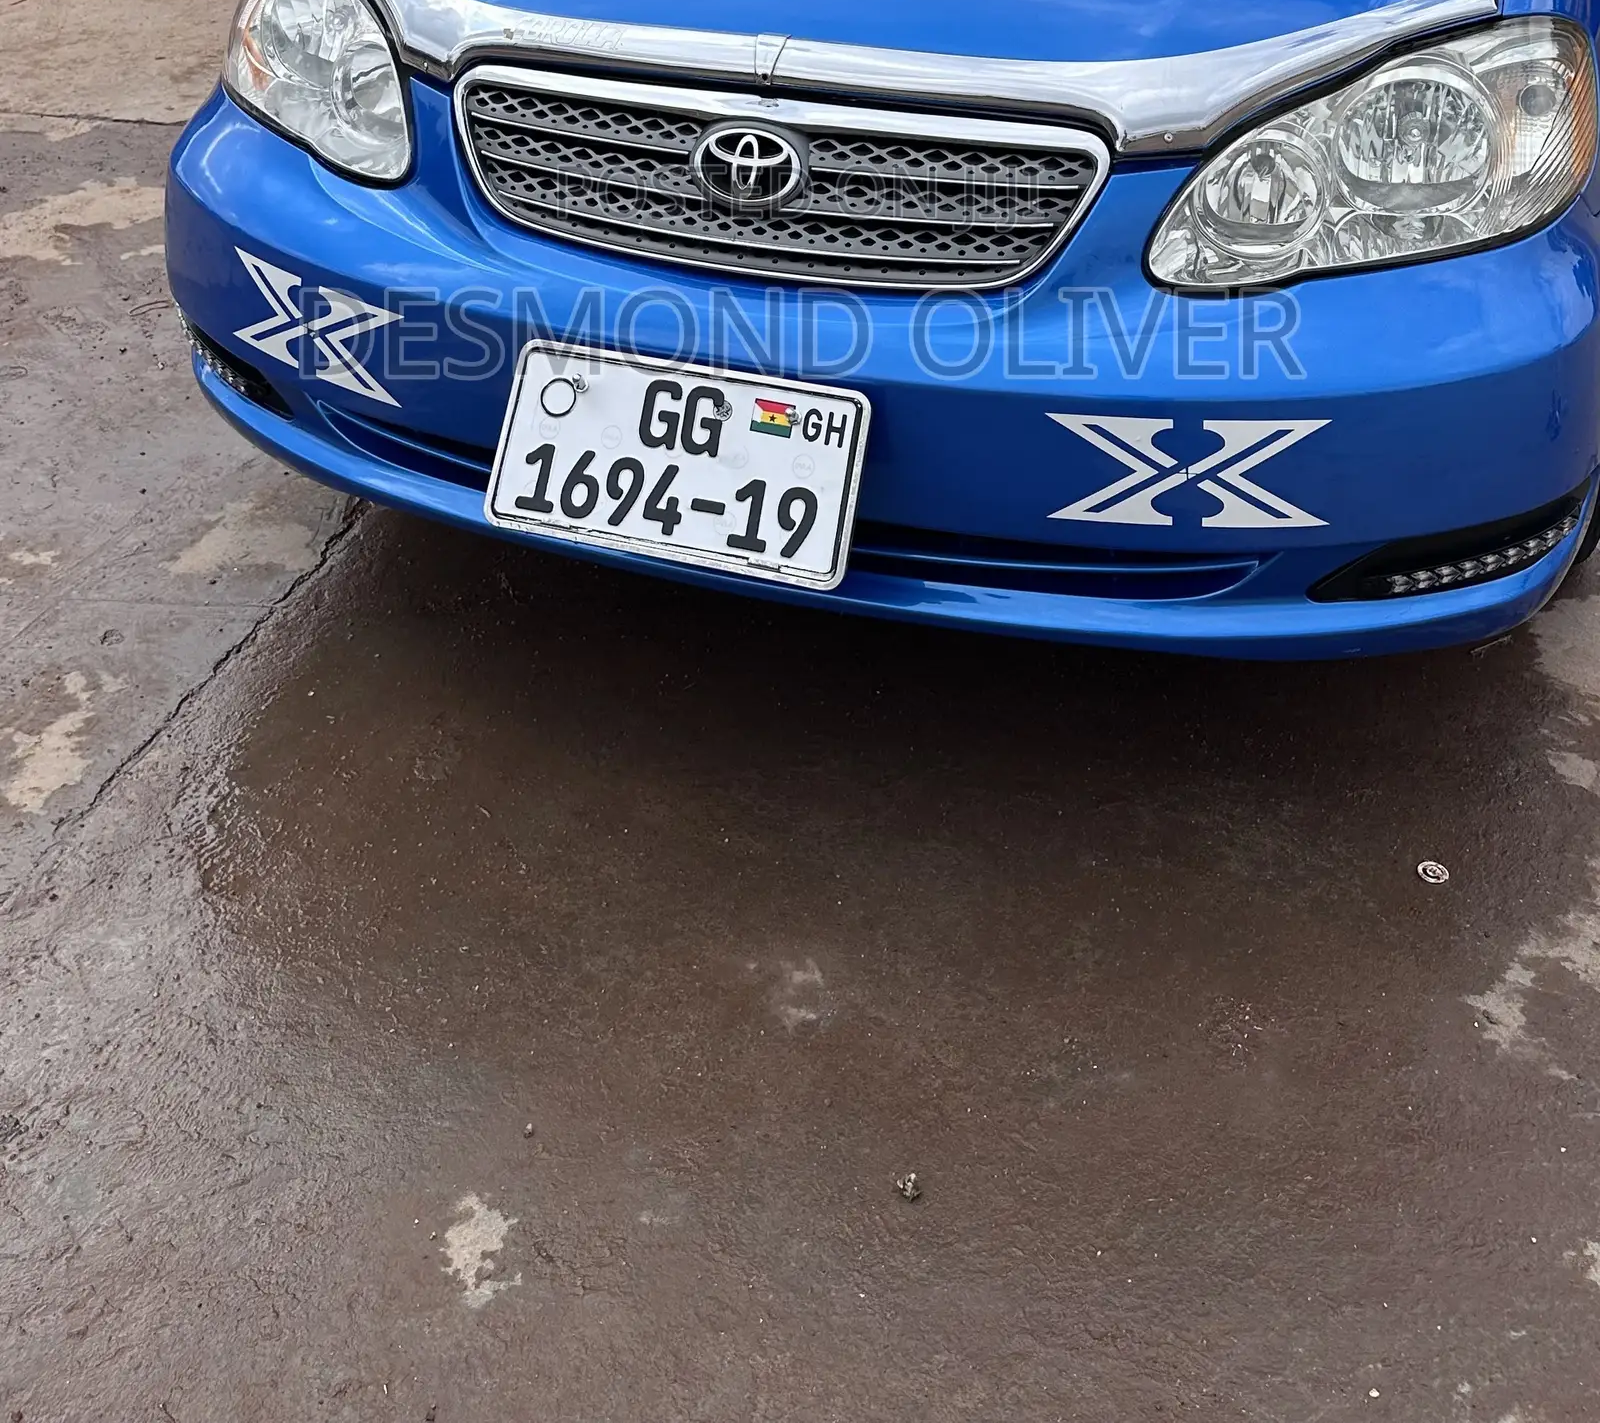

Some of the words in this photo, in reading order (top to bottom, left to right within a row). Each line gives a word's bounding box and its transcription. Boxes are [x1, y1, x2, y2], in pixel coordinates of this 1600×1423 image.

[638, 379, 724, 458] GG
[801, 407, 848, 449] GH
[514, 443, 819, 559] 1694-19
